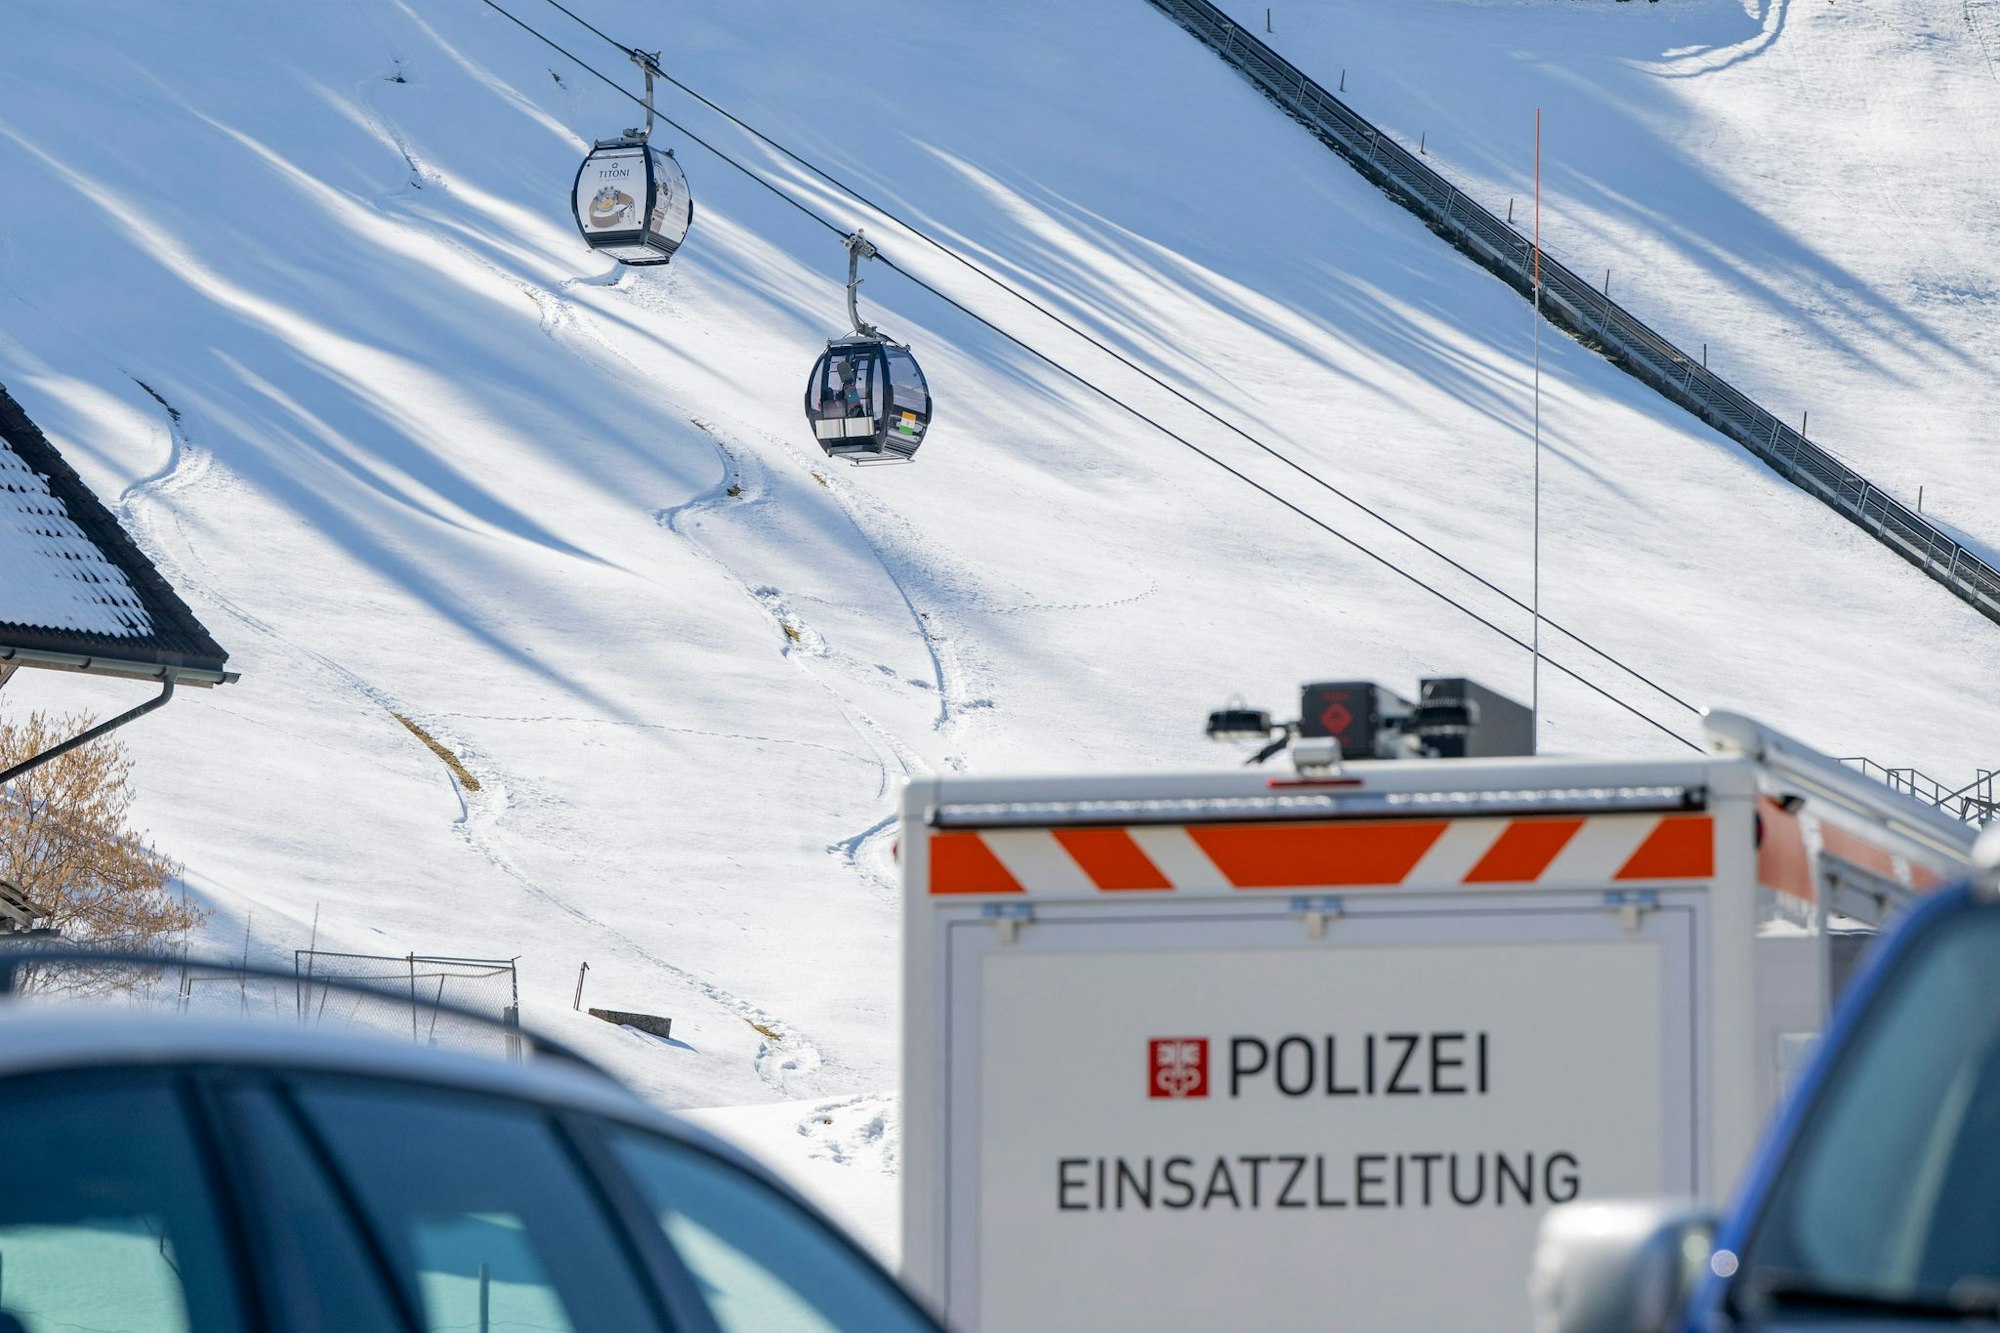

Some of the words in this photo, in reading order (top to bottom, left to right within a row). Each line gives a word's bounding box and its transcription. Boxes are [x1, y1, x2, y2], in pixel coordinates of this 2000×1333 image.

[599, 169, 630, 178] TITONI
[1229, 1032, 1488, 1097] POLIZEI
[1058, 1152, 1580, 1211] EINSATZLEITUNG
